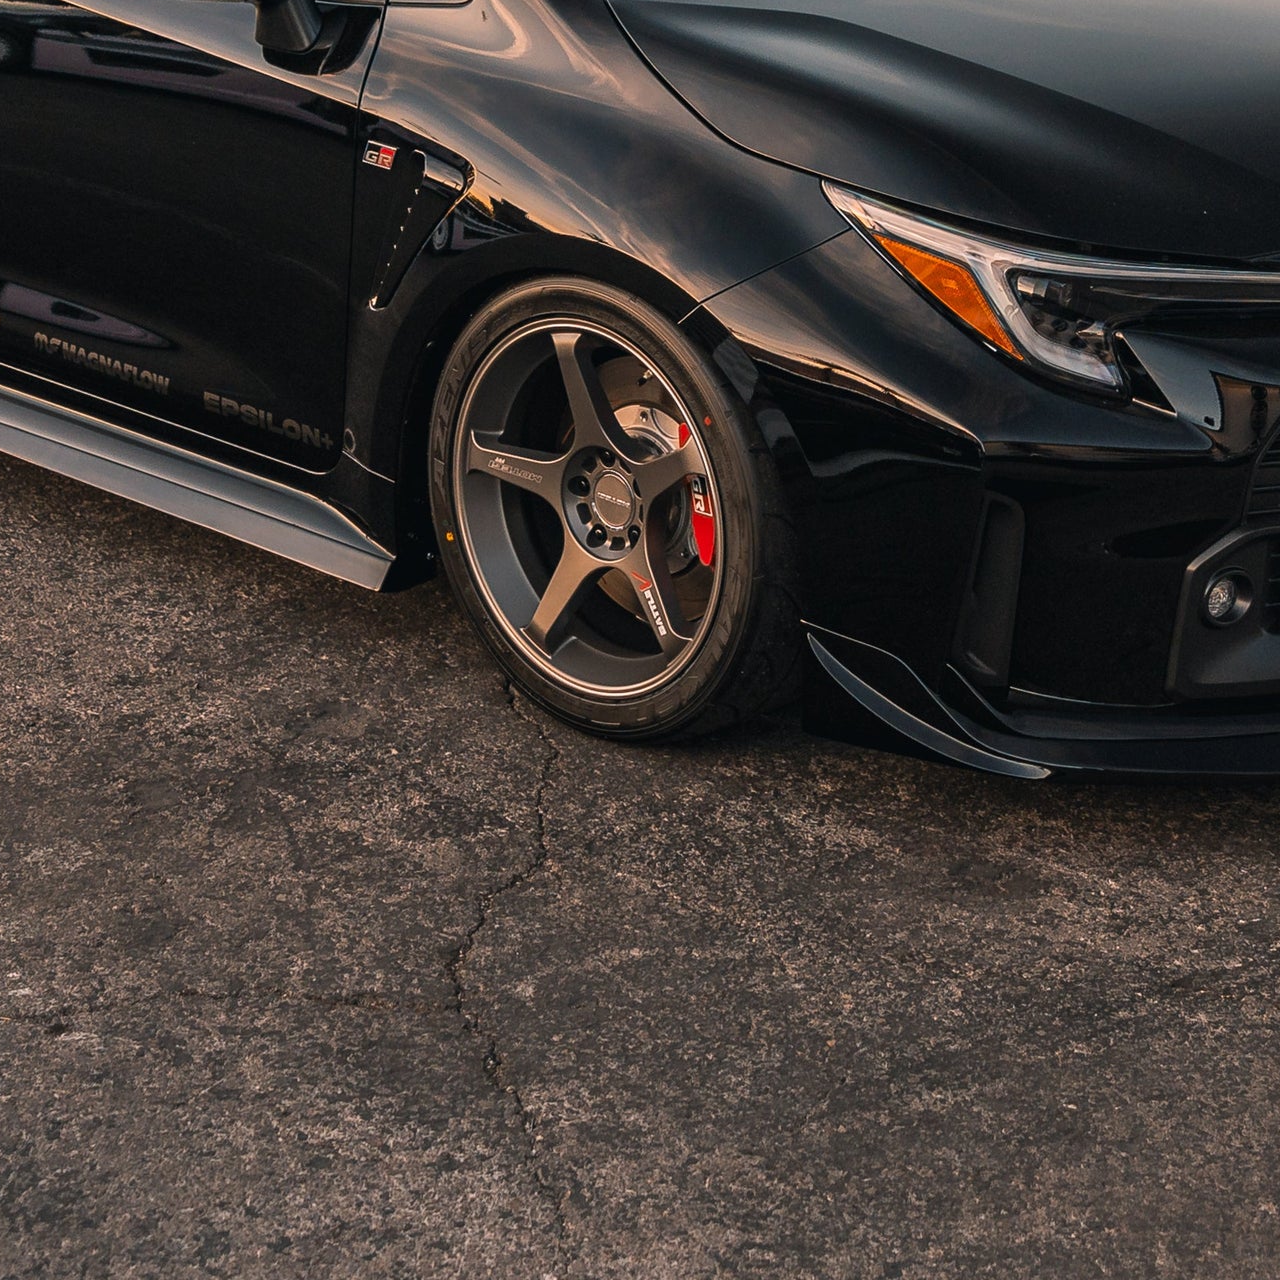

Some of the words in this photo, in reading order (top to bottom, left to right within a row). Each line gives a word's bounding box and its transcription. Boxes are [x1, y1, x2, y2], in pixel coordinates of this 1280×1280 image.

[364, 149, 394, 169] GR
[62, 341, 170, 396] MAGNAFLOW
[203, 391, 335, 451] EPSILON+
[691, 477, 707, 512] GR
[643, 589, 668, 637] BATTLE
